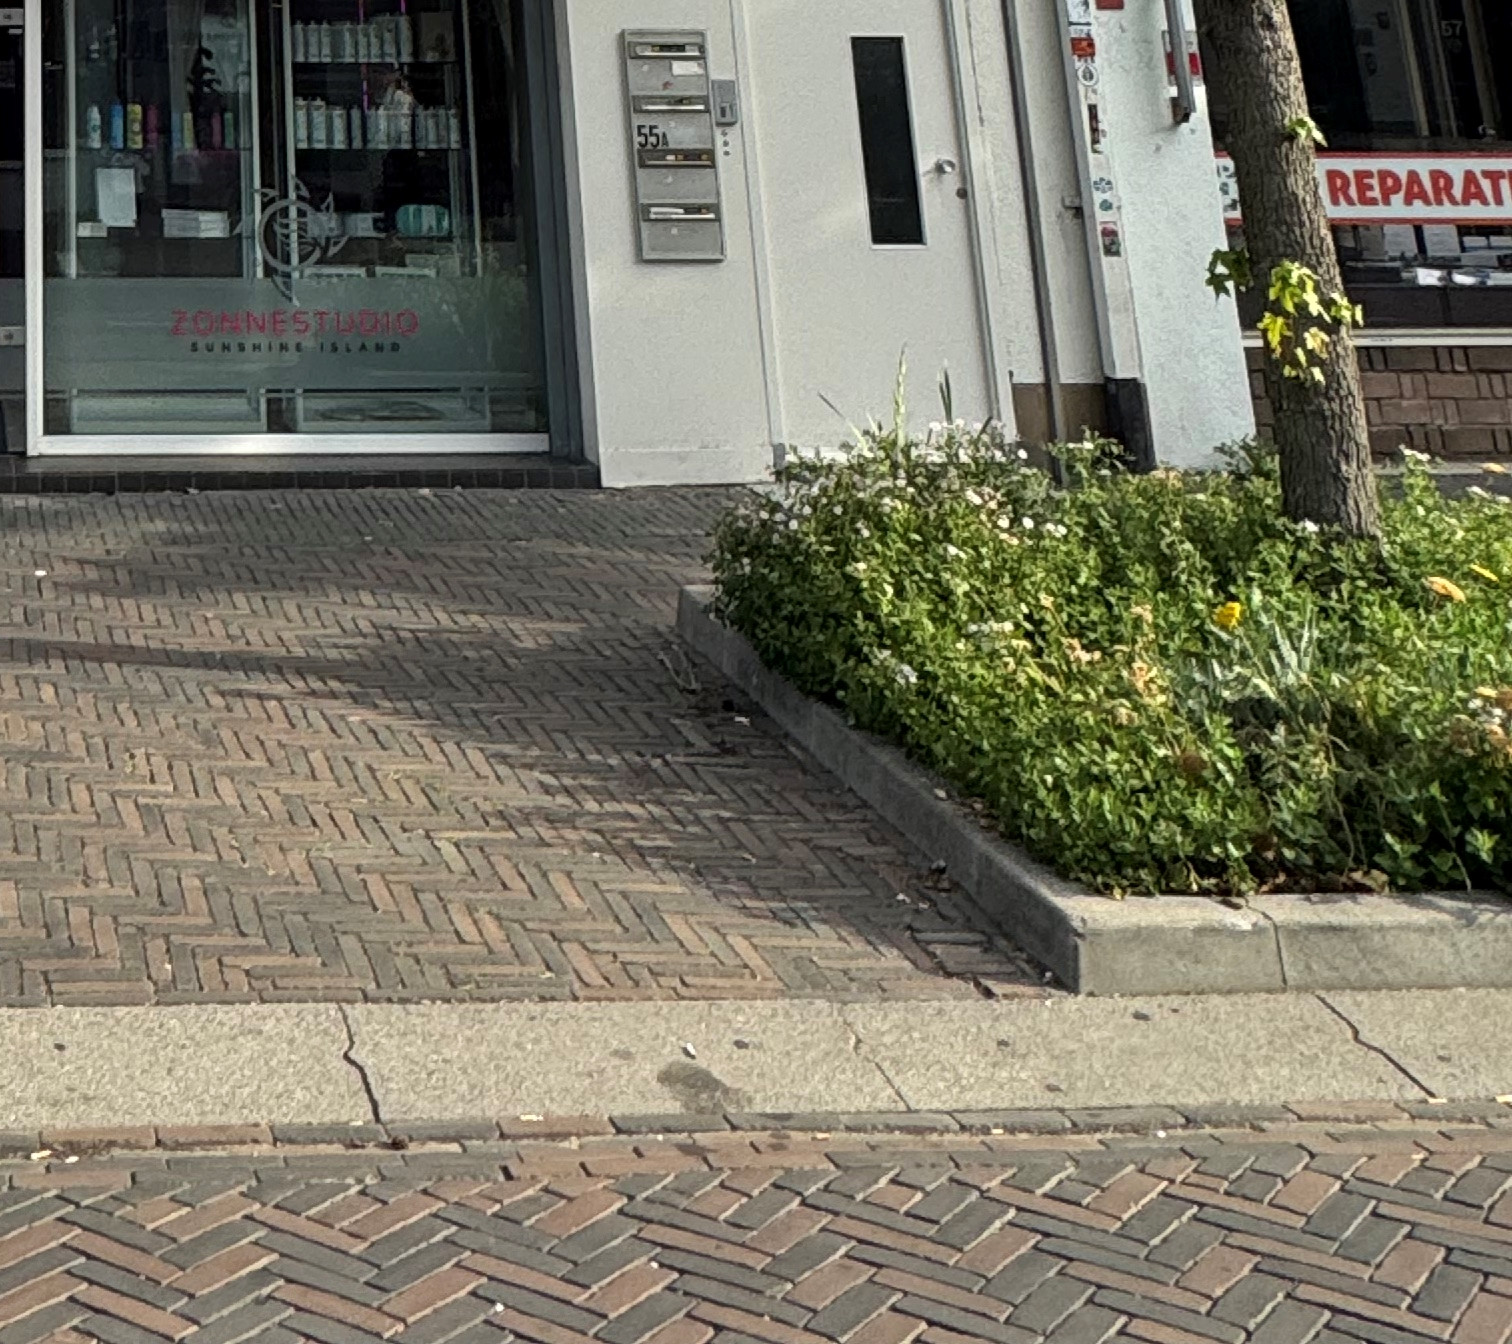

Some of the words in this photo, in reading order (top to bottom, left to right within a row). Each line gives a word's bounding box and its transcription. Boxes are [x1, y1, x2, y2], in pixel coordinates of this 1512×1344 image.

[170, 308, 420, 337] ZONNESTUDIO
[190, 341, 304, 354] SUNSHINE
[319, 341, 401, 354] ISLAND
